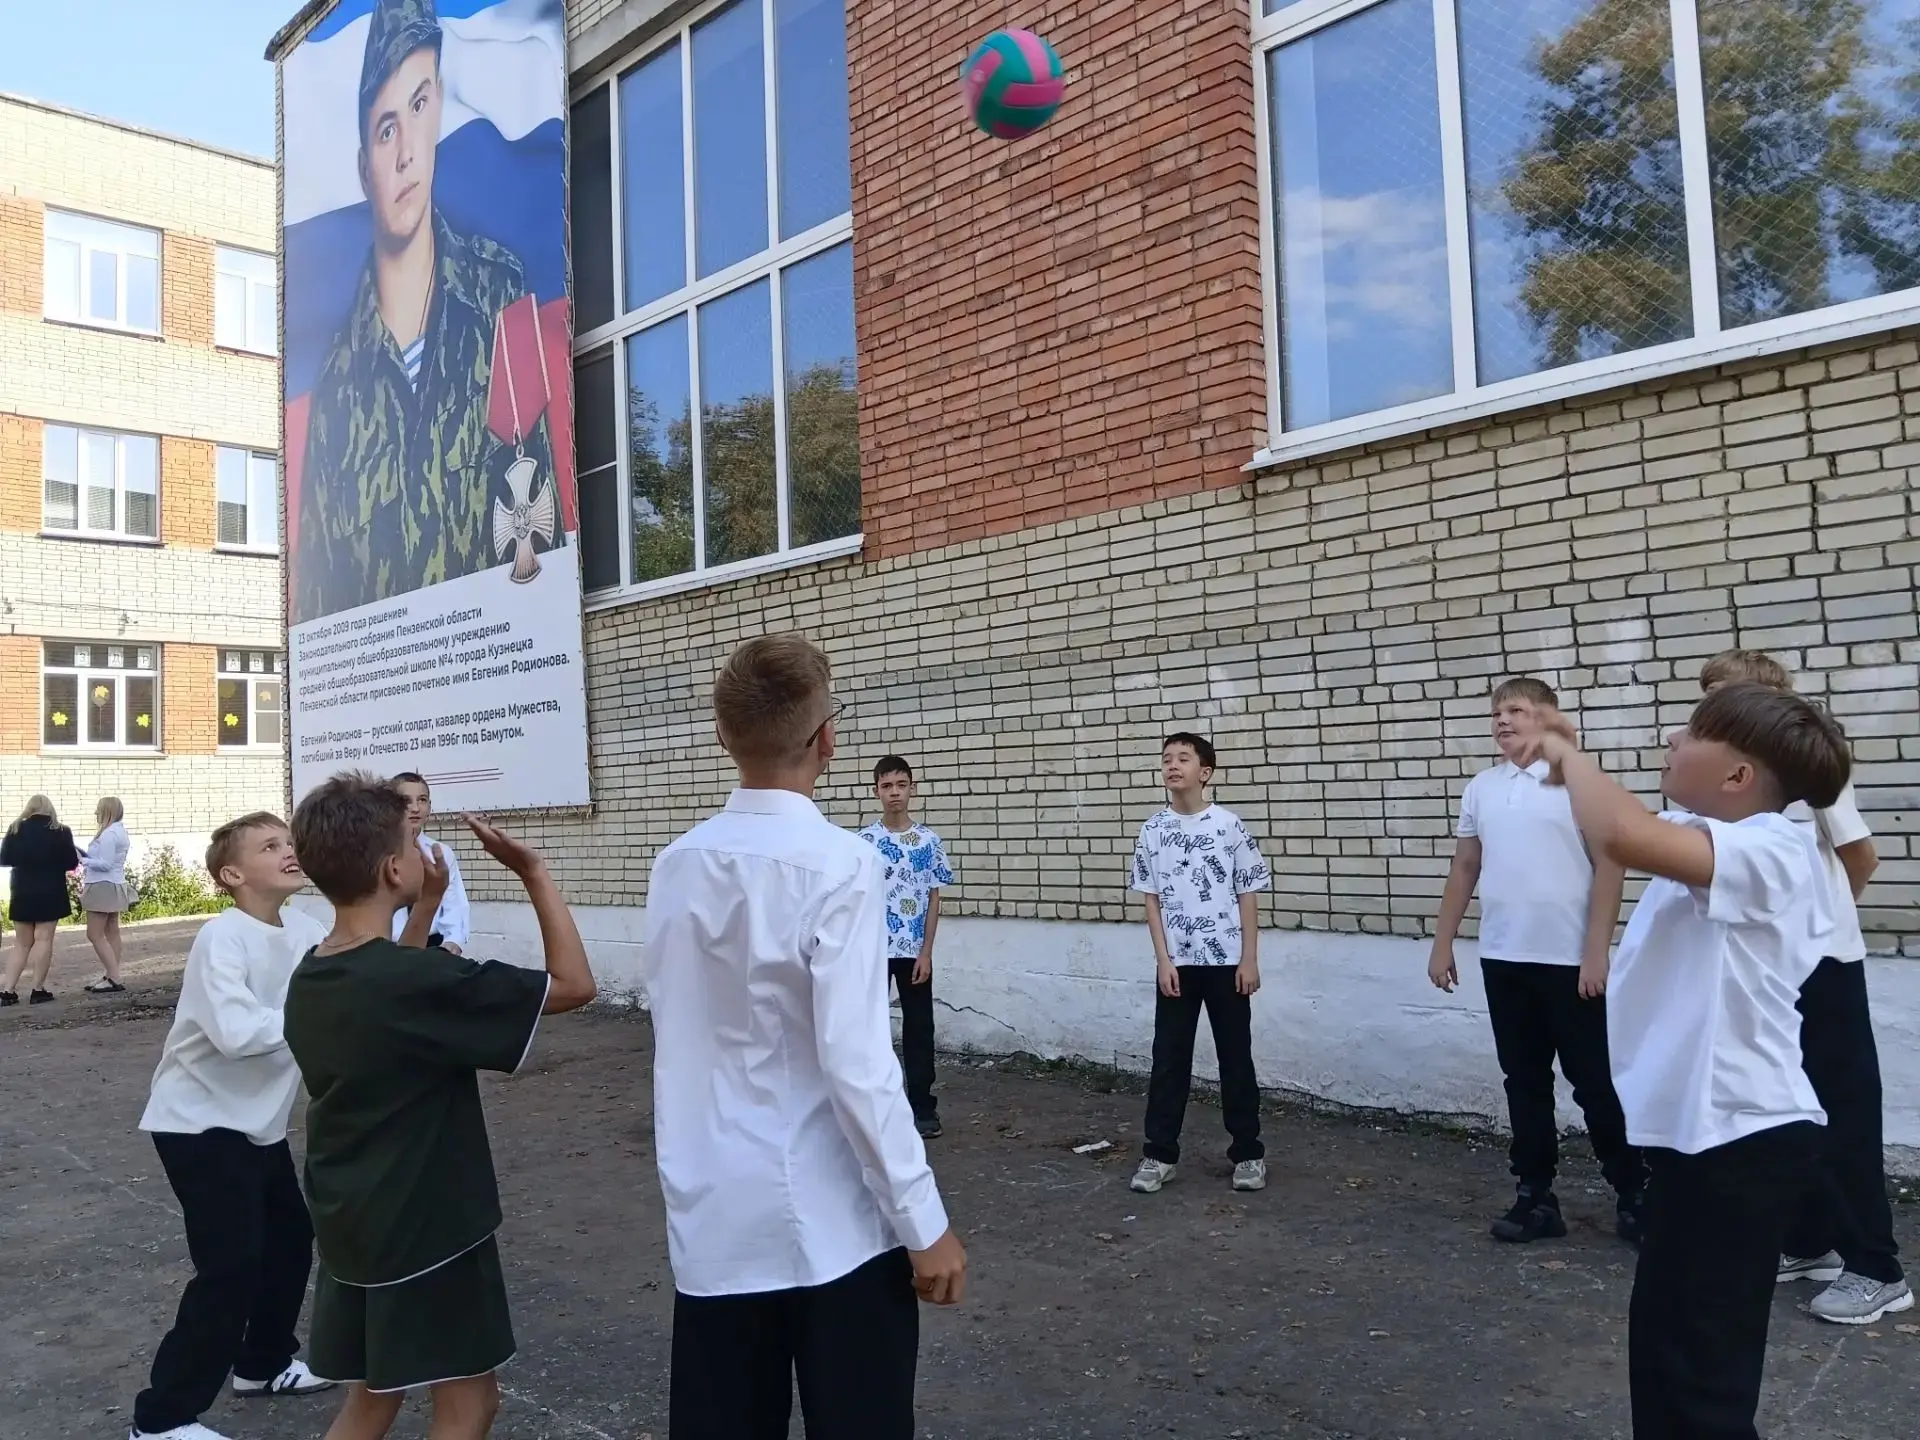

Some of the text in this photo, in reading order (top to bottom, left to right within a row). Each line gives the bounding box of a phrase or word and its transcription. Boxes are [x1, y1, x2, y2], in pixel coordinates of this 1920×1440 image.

[298, 607, 408, 644] 23 октября 2009 года решением
[299, 607, 482, 661] Законодательного собрания Пензенской области
[299, 657, 355, 680] муниципальному
[357, 635, 450, 666] общеобразовательному
[451, 621, 511, 648] учреждению
[299, 638, 533, 697] средней общеобразовательной школе №4 города Кузнецка
[299, 653, 570, 712] Пензенской области присвоено почетное имя Евгения Родионова.
[300, 732, 327, 746] Евгений
[328, 729, 362, 743] Родионов
[372, 720, 403, 739] русский
[404, 718, 434, 731] солдат,
[435, 713, 470, 728] кавалер
[472, 707, 506, 724] ордена
[508, 699, 561, 719] Мужества,
[301, 726, 524, 763] погибший за Веру и Отечество 23 мая 1996г под Бамутом.
